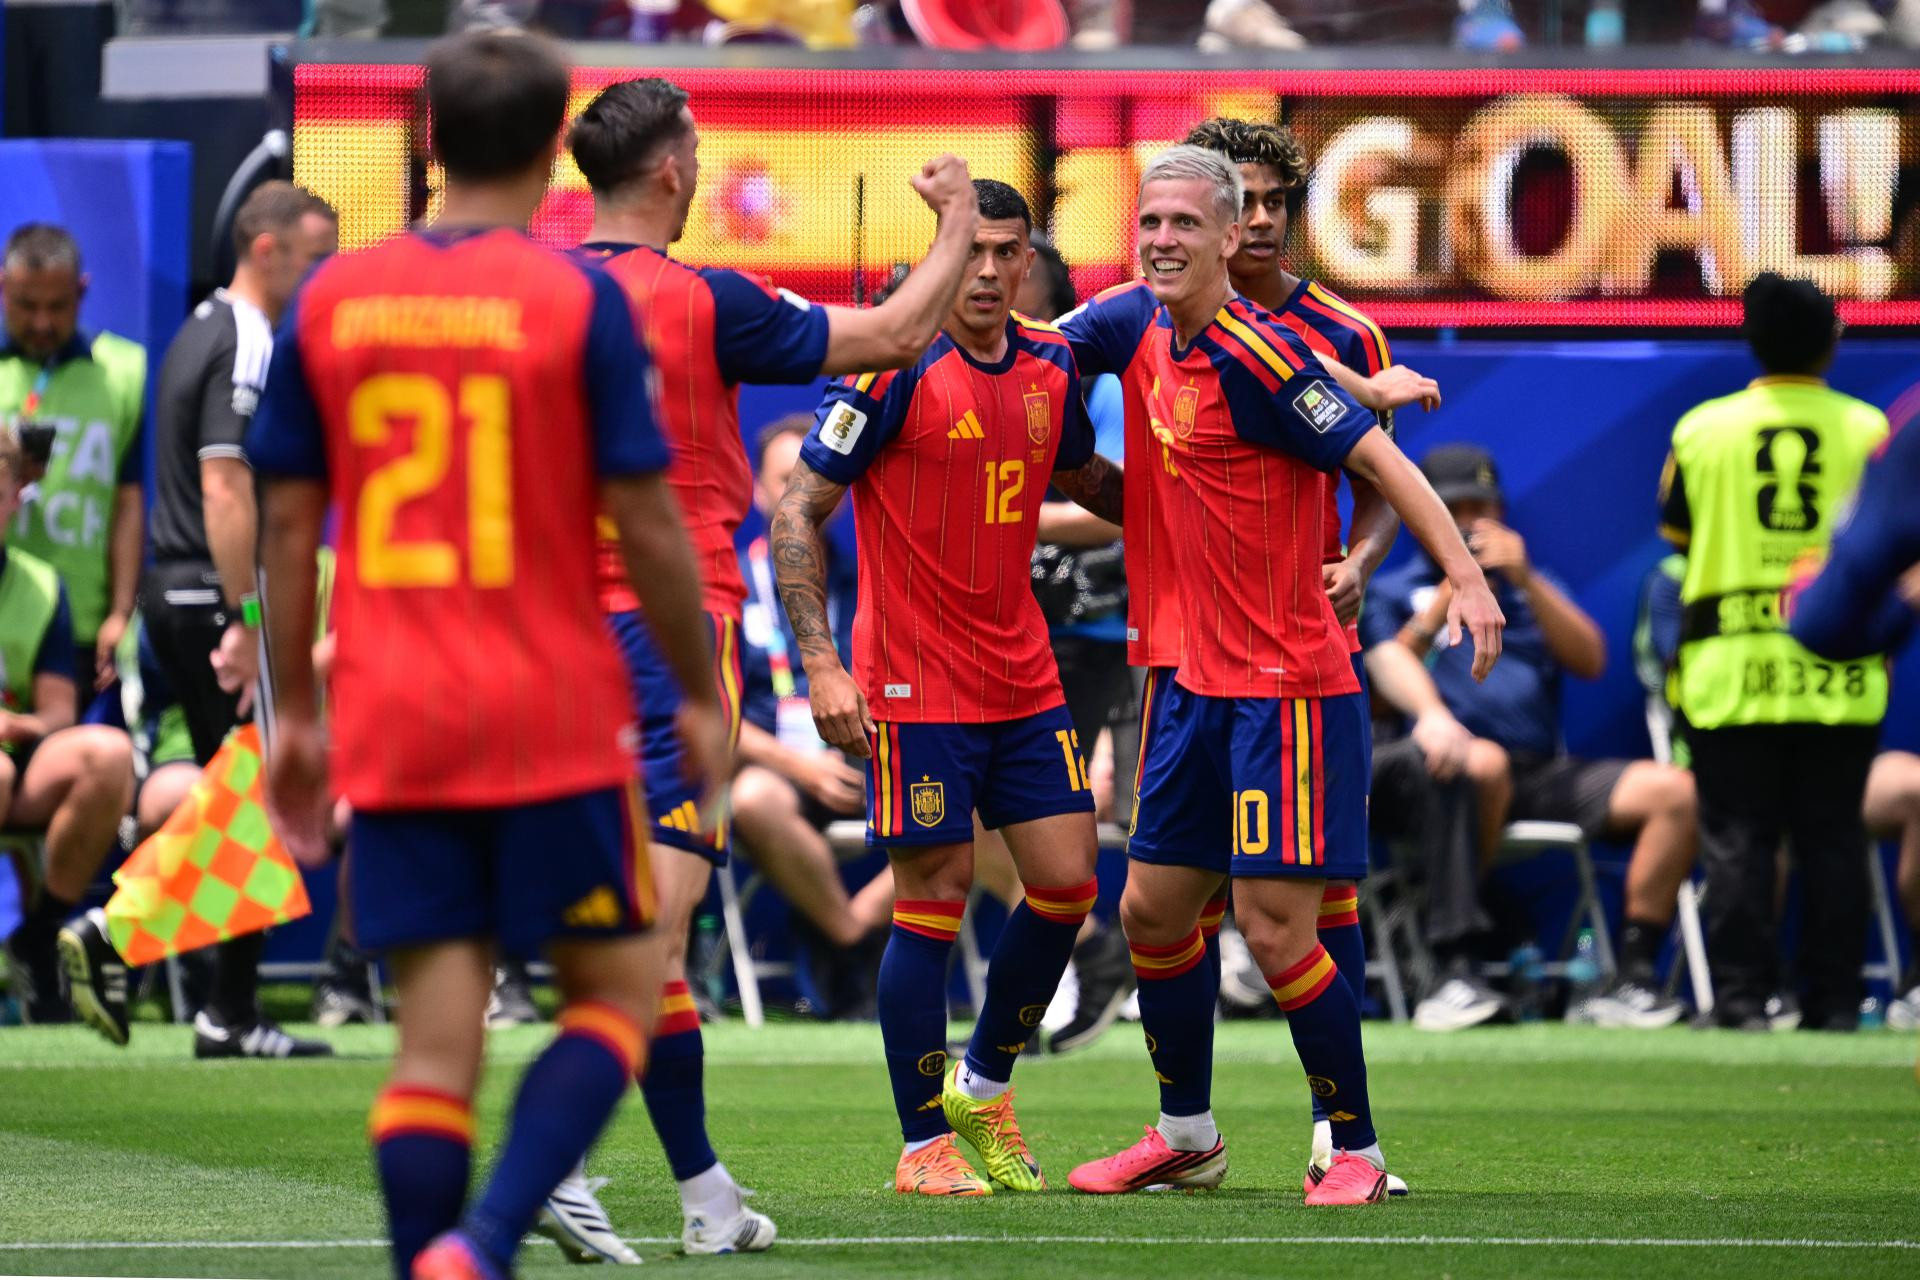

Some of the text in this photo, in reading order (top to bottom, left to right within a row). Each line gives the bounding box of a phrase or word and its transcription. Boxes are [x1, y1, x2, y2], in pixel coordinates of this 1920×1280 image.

[1305, 93, 1899, 300] GOAL!
[348, 372, 515, 589] 21
[985, 459, 1025, 524] 12
